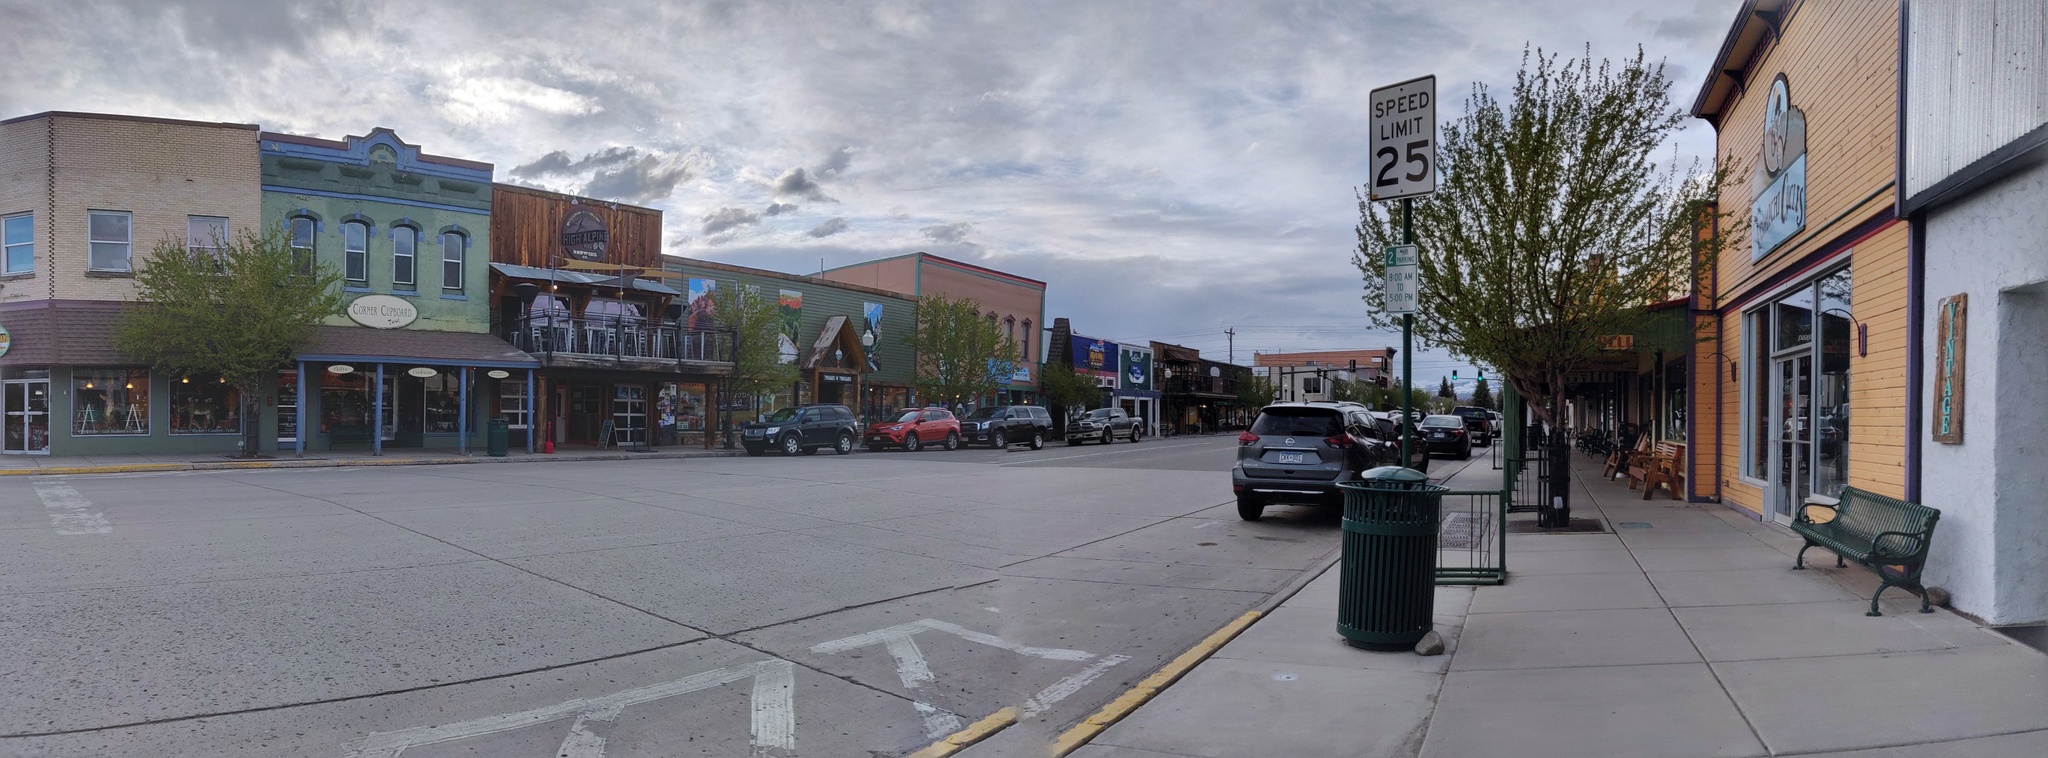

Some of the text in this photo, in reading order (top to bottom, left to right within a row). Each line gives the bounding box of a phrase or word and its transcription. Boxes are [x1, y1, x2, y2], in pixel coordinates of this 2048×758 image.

[1375, 91, 1429, 118] SPEED
[1381, 116, 1423, 140] LIMIT
[1376, 139, 1429, 188] 25
[563, 230, 608, 245] HIGH ALPINE
[1388, 252, 1394, 263] 2
[1389, 272, 1412, 281] 8:00 AM
[1397, 283, 1403, 291] TO
[1390, 293, 1412, 302] 5:00 PM
[353, 303, 412, 317] CORNER CUPBOARD
[1942, 303, 1956, 435] VINTAGE
